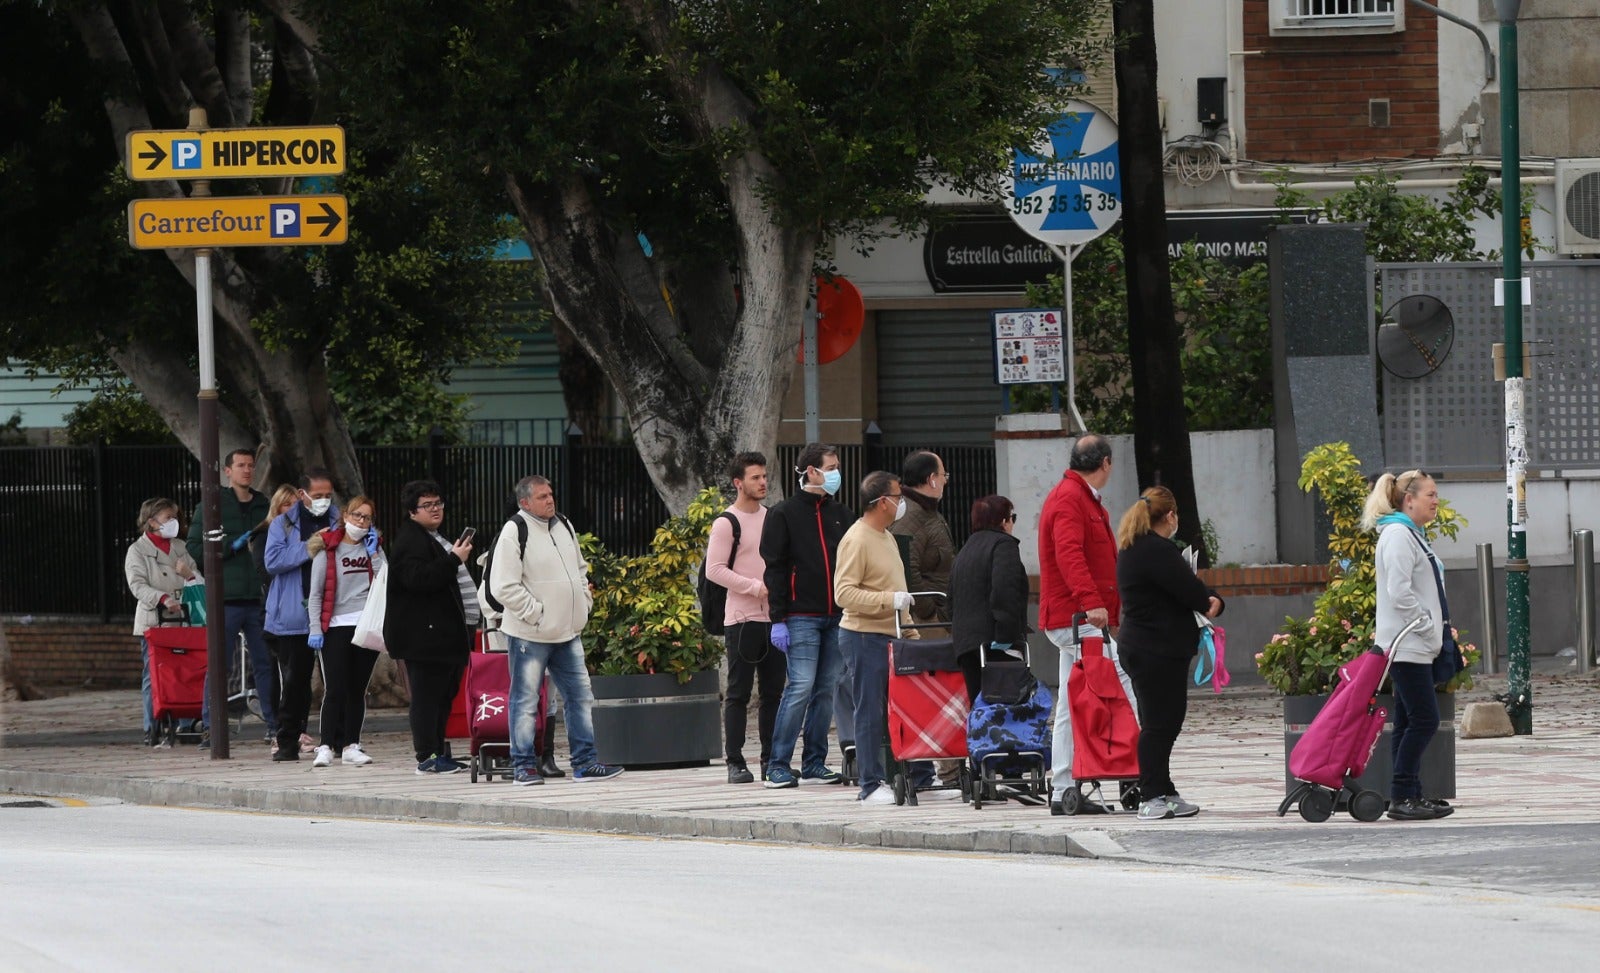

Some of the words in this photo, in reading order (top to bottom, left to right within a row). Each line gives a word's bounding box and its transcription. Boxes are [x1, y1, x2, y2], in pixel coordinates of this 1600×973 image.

[177, 142, 197, 167] P
[213, 139, 337, 167] HIPERCOR
[1013, 195, 1043, 215] 952
[1048, 194, 1068, 213] 35
[1073, 193, 1092, 212] 35
[1097, 192, 1117, 211] 35
[138, 209, 265, 234] Carrefour
[275, 208, 296, 234] P
[946, 245, 1000, 265] Estrella
[1002, 244, 1053, 264] Galicia
[1167, 241, 1232, 258] ANONIO
